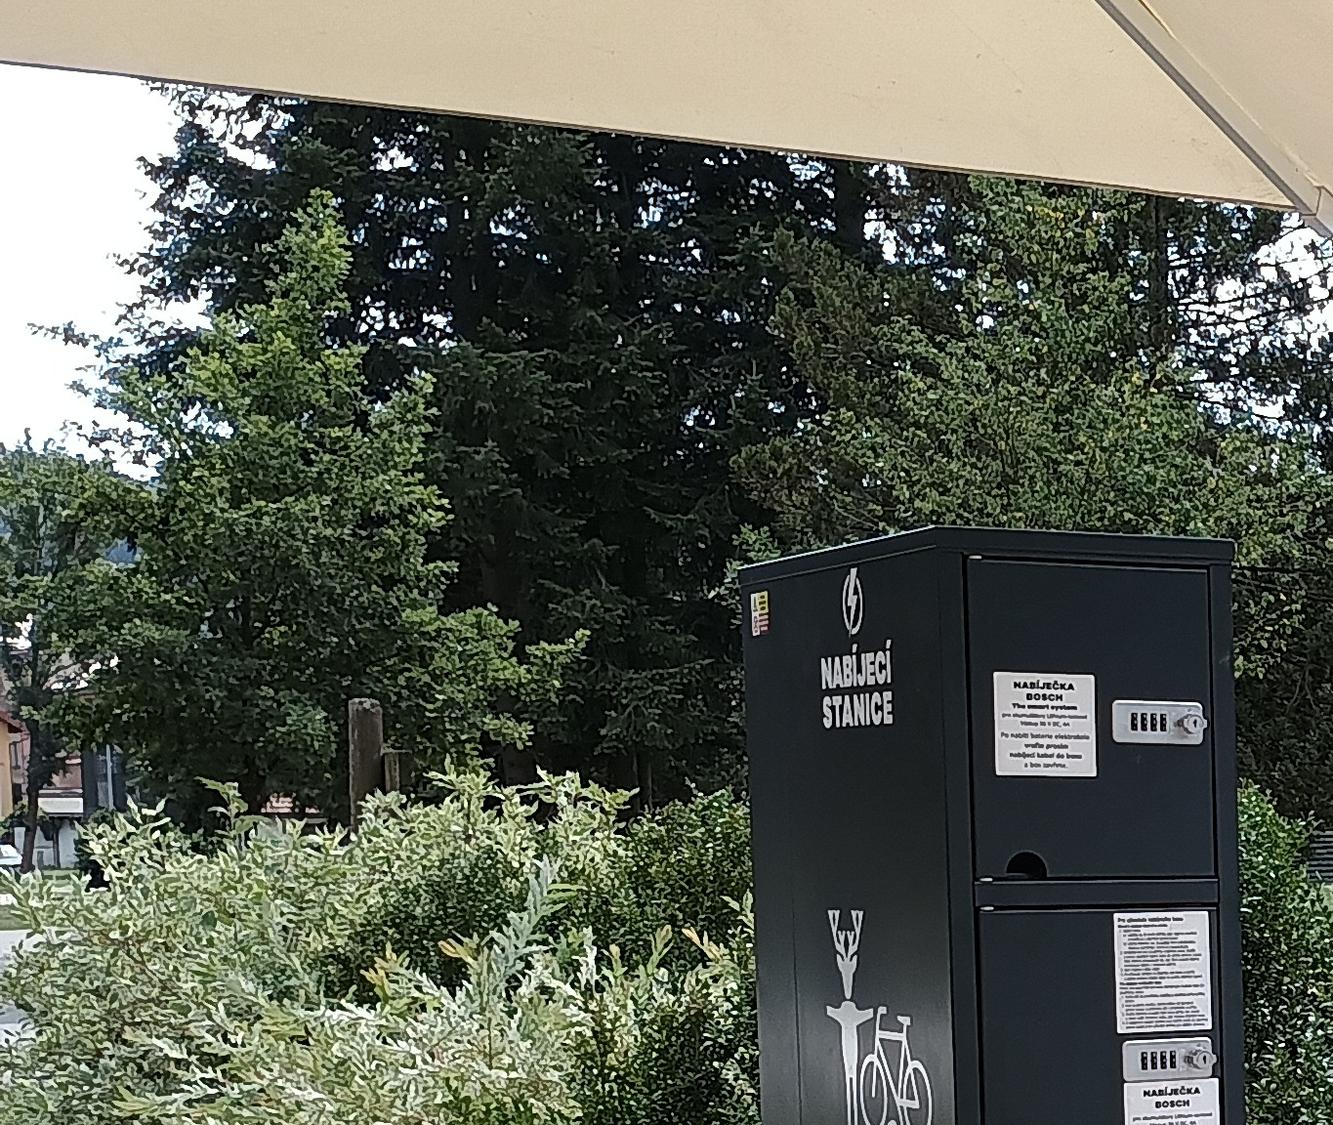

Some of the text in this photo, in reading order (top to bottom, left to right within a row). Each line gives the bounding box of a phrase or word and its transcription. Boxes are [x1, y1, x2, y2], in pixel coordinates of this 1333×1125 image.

[820, 639, 892, 690] NABÍJECÍ
[1013, 679, 1075, 691] NABÍJEČKA
[1026, 693, 1063, 702] BOSCH
[822, 691, 893, 729] STANICE
[1143, 1085, 1201, 1097] NABÍJEČKA
[1155, 1099, 1190, 1109] BOSCH
